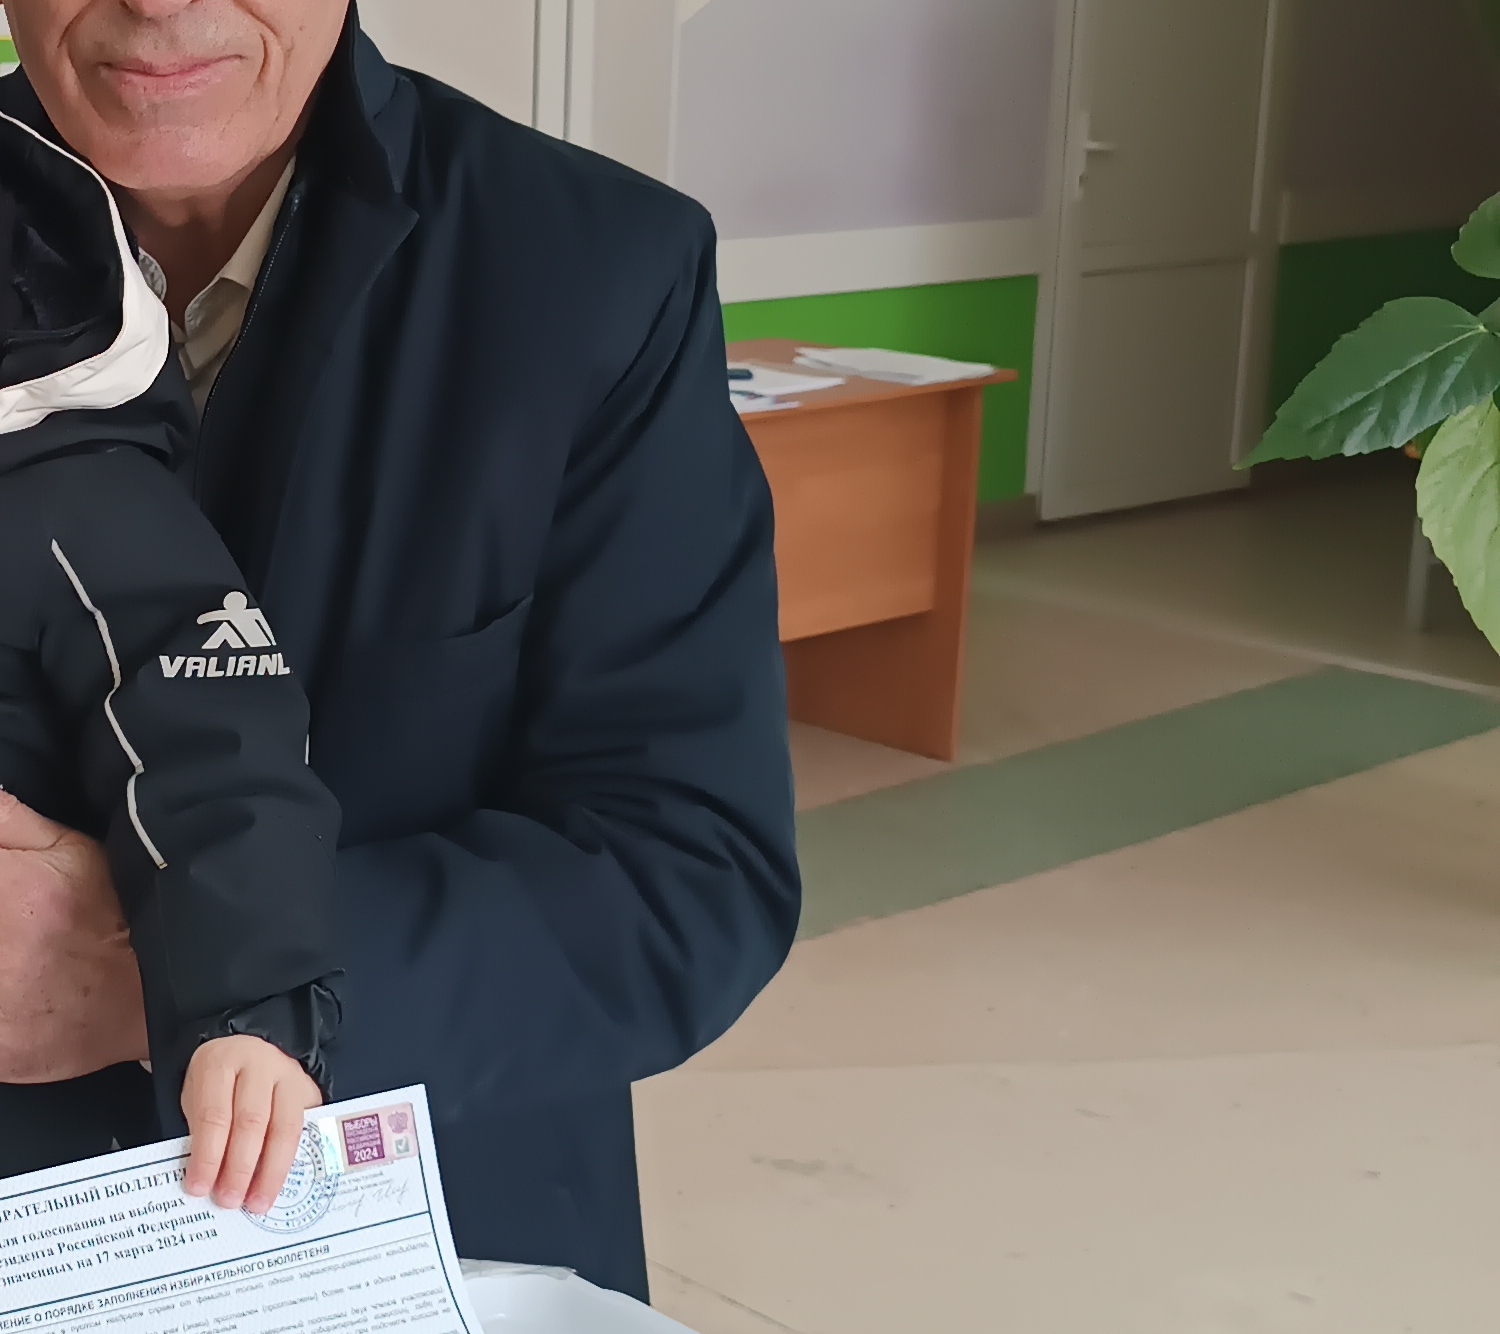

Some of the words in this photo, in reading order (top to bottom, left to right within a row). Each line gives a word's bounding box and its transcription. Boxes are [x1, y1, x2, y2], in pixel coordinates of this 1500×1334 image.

[353, 1145, 379, 1163] 2024
[23, 1217, 105, 1243] голосования
[110, 1212, 125, 1222] на
[129, 1199, 185, 1218] выборах
[57, 1227, 134, 1254] Российской
[77, 1255, 93, 1270] на
[96, 1250, 110, 1264] 17
[114, 1244, 154, 1261] марта
[158, 1234, 186, 1251] 2024
[189, 1227, 219, 1244] года
[34, 1313, 42, 1321] О
[45, 1301, 94, 1320] ПОРЯДКЕ
[97, 1284, 167, 1308] ЗАПОЛНЕНИЯ
[170, 1261, 264, 1291] ИЗБИРАТЕЛЬНОГО
[267, 1245, 329, 1268] БЮЛЛЕТЕНЯ
